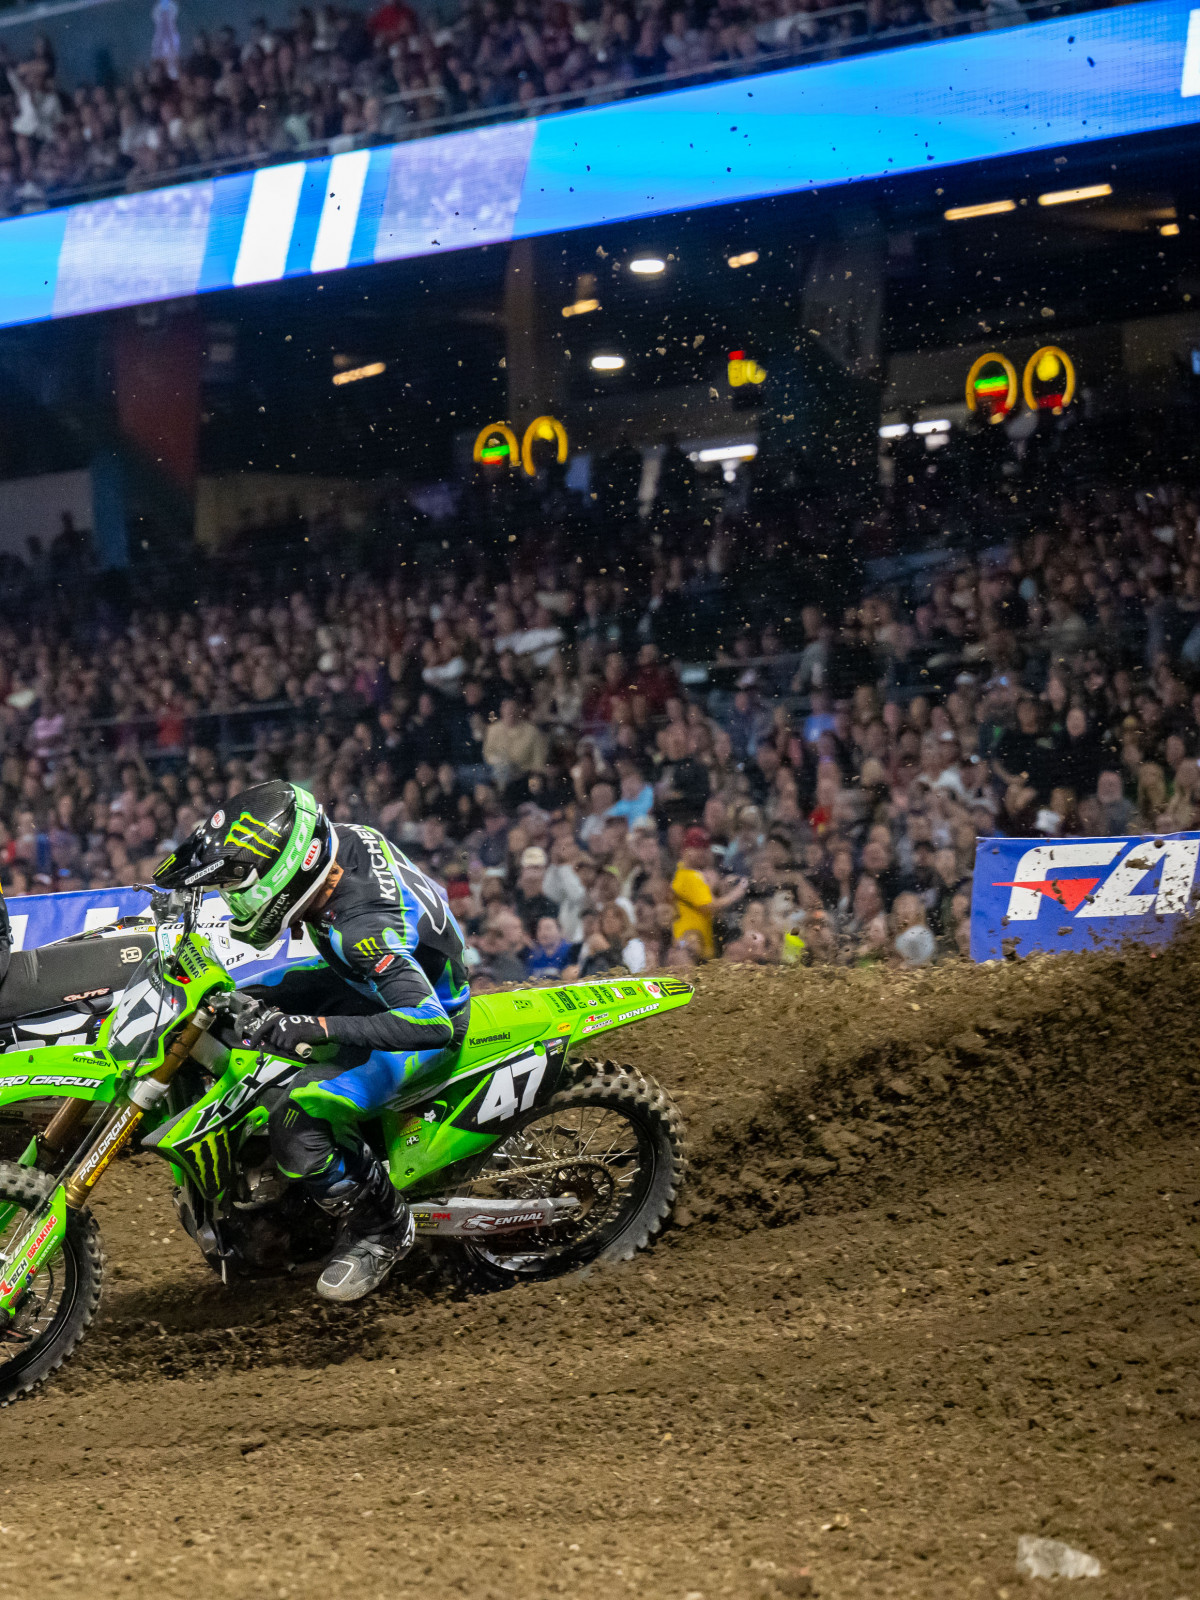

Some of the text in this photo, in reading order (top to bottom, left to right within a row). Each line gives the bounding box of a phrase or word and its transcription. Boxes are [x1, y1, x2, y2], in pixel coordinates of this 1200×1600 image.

[305, 844, 319, 868] BELL
[180, 949, 202, 980] ENTHA
[617, 1003, 660, 1022] DUNLOP
[468, 1032, 511, 1047] Kawasaki
[72, 1056, 112, 1068] KITCHEN
[29, 1075, 106, 1089] CIRCUIT
[477, 1053, 548, 1125] 47
[79, 1155, 101, 1181] PRO
[97, 1106, 133, 1155] CIRCUIT
[106, 1117, 139, 1162] SHOWA
[27, 1215, 58, 1260] BRAKING
